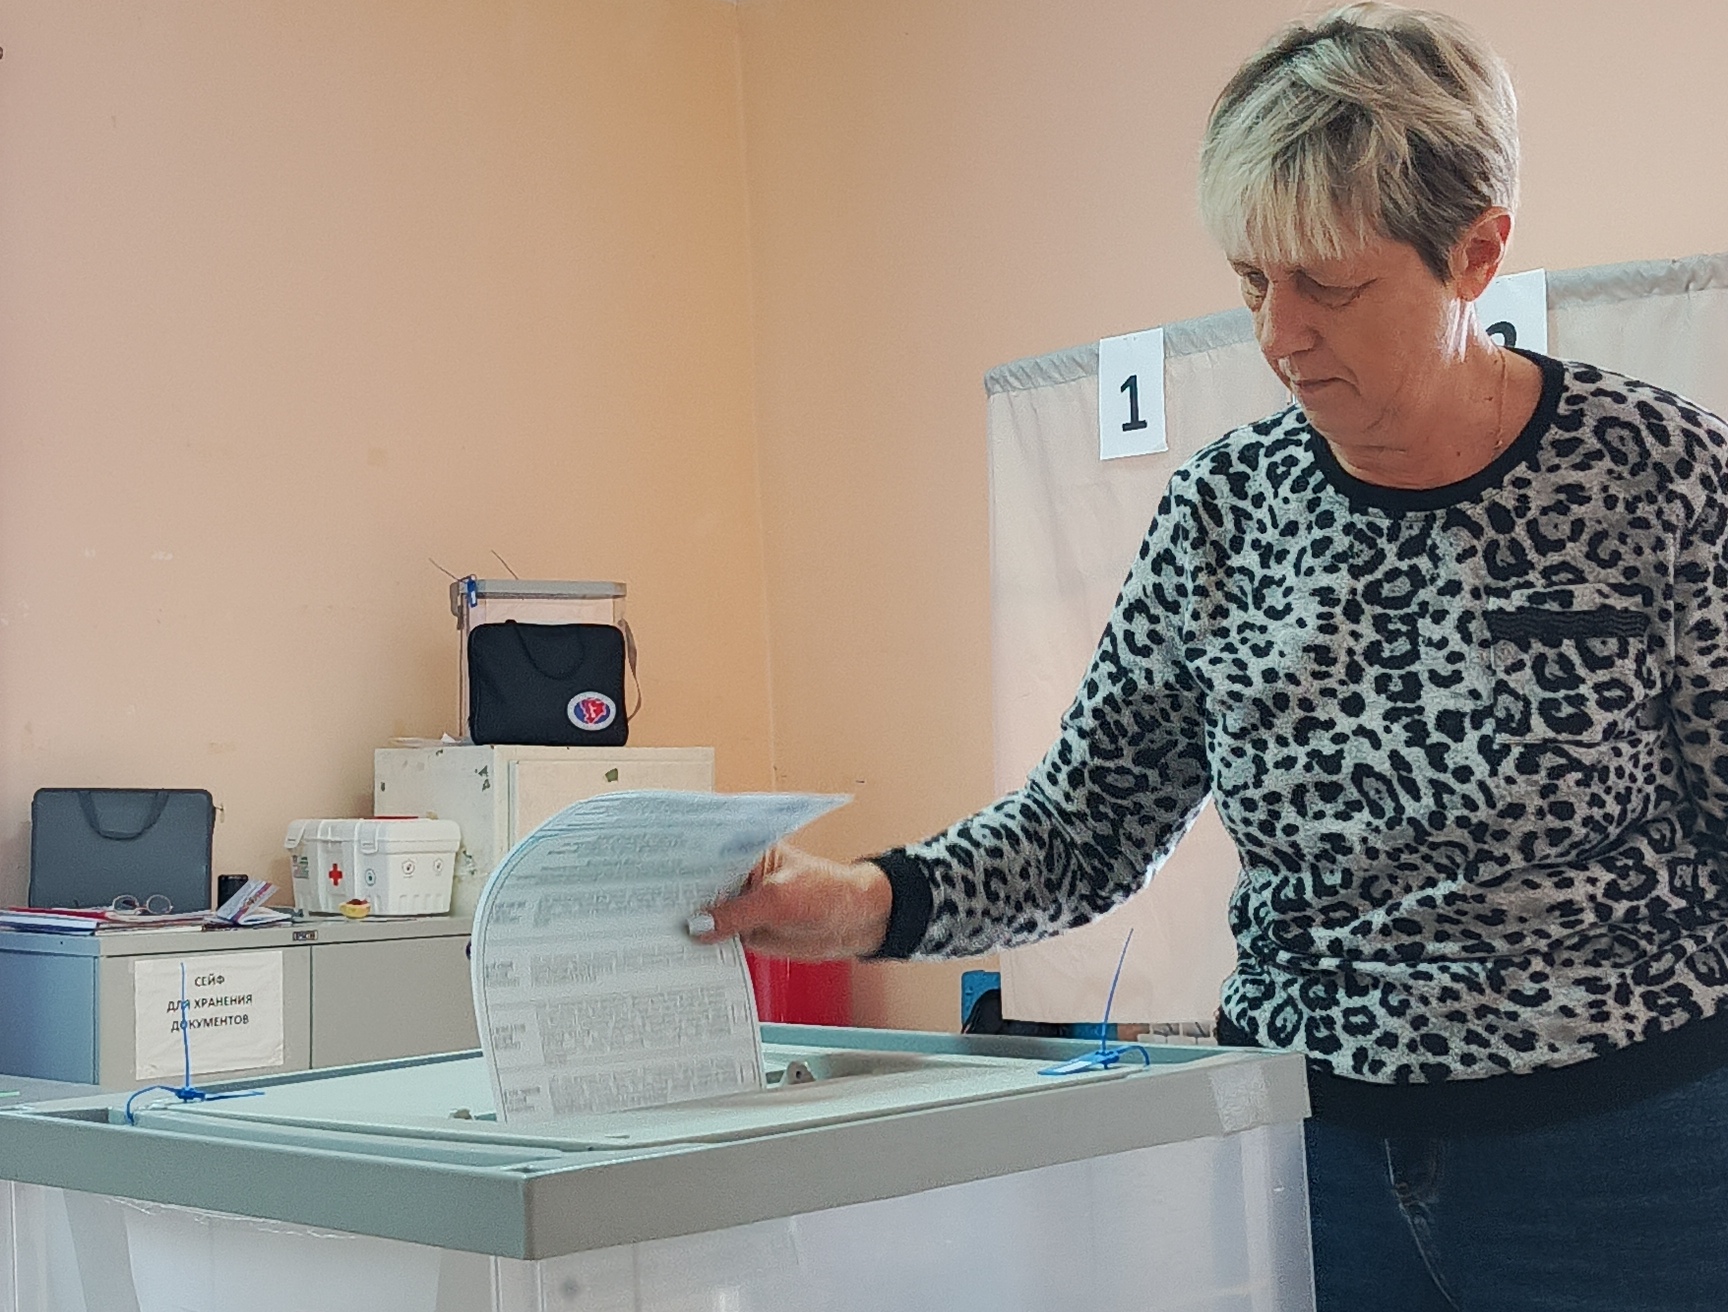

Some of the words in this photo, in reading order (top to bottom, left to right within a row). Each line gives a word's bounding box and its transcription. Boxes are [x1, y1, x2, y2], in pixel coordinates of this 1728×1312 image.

[1119, 374, 1148, 432] 1
[194, 973, 226, 988] СЕЙФ
[193, 993, 253, 1010] ХРАНЕНИЯ
[170, 1013, 250, 1034] ДОКУМЕНТОВ
